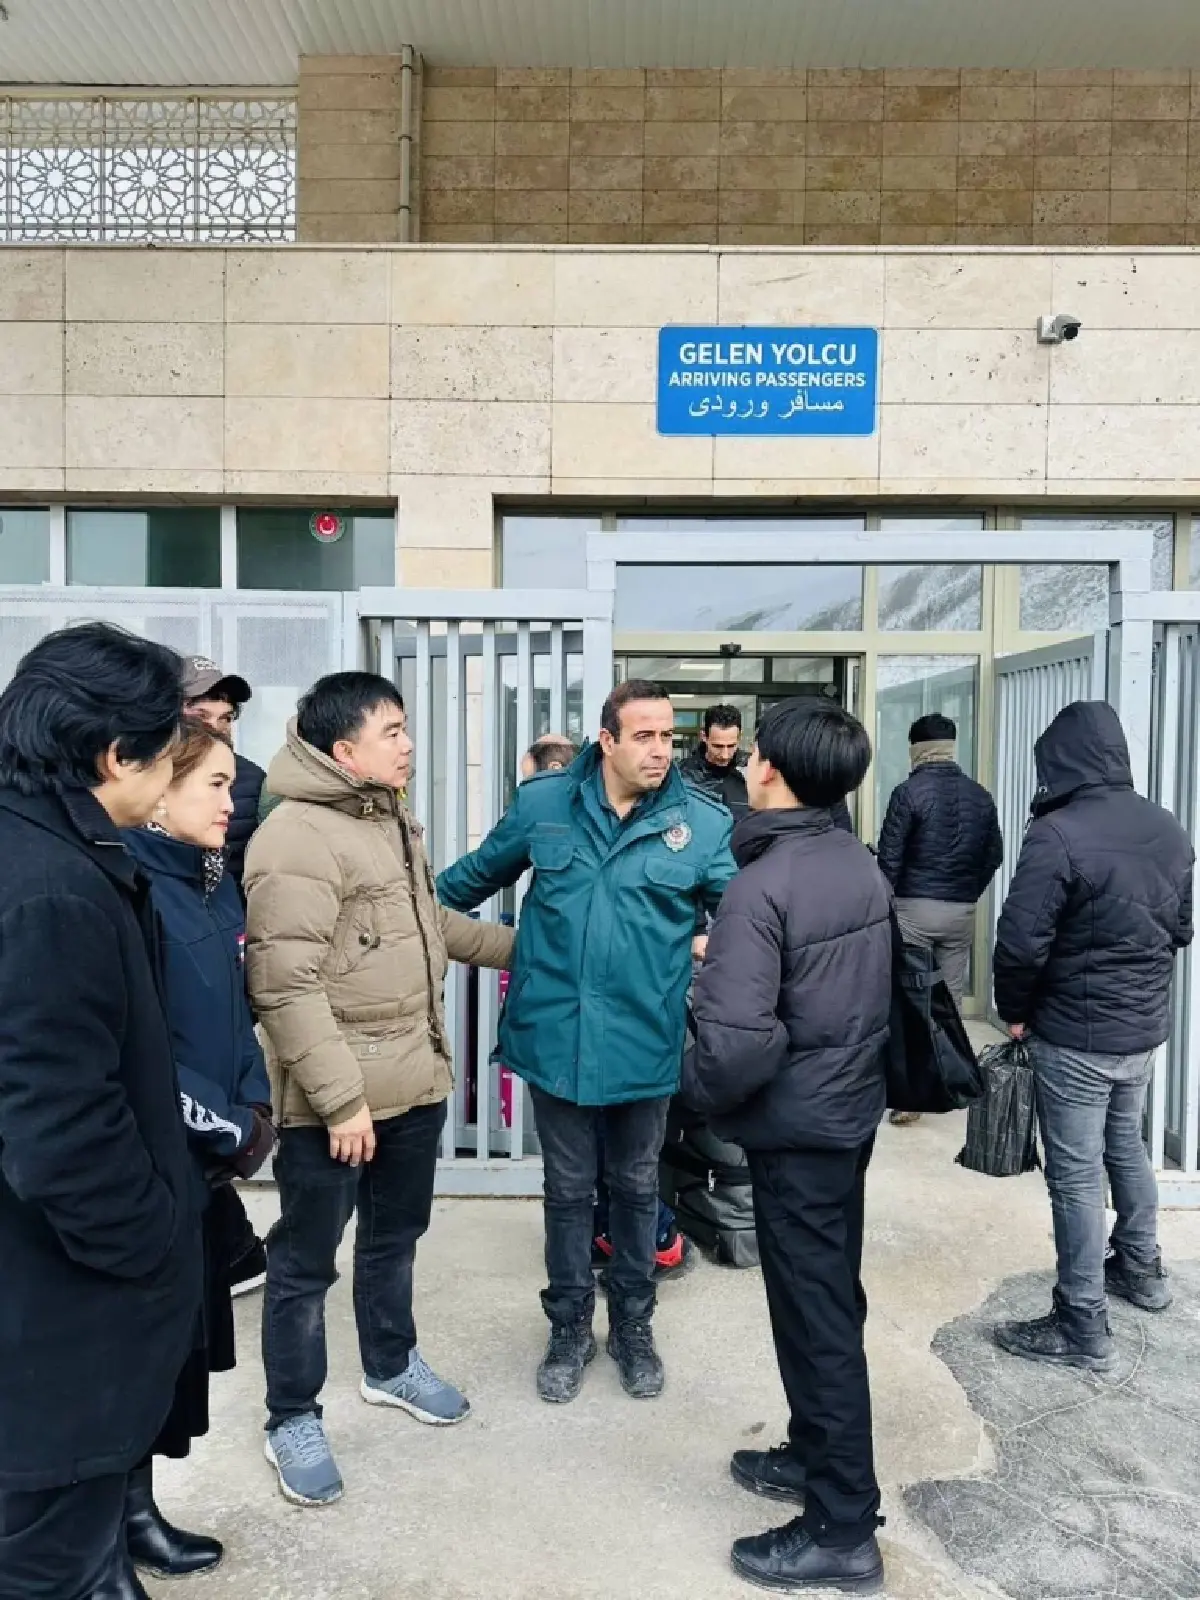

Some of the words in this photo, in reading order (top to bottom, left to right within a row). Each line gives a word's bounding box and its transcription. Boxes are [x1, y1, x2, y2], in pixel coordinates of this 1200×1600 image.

[679, 342, 763, 365] GELEN
[770, 343, 857, 366] YOLCU
[668, 371, 752, 387] ARRIVING
[756, 371, 867, 387] PASSENGERS
[688, 393, 770, 418] ورودی
[778, 388, 845, 419] مسافر
